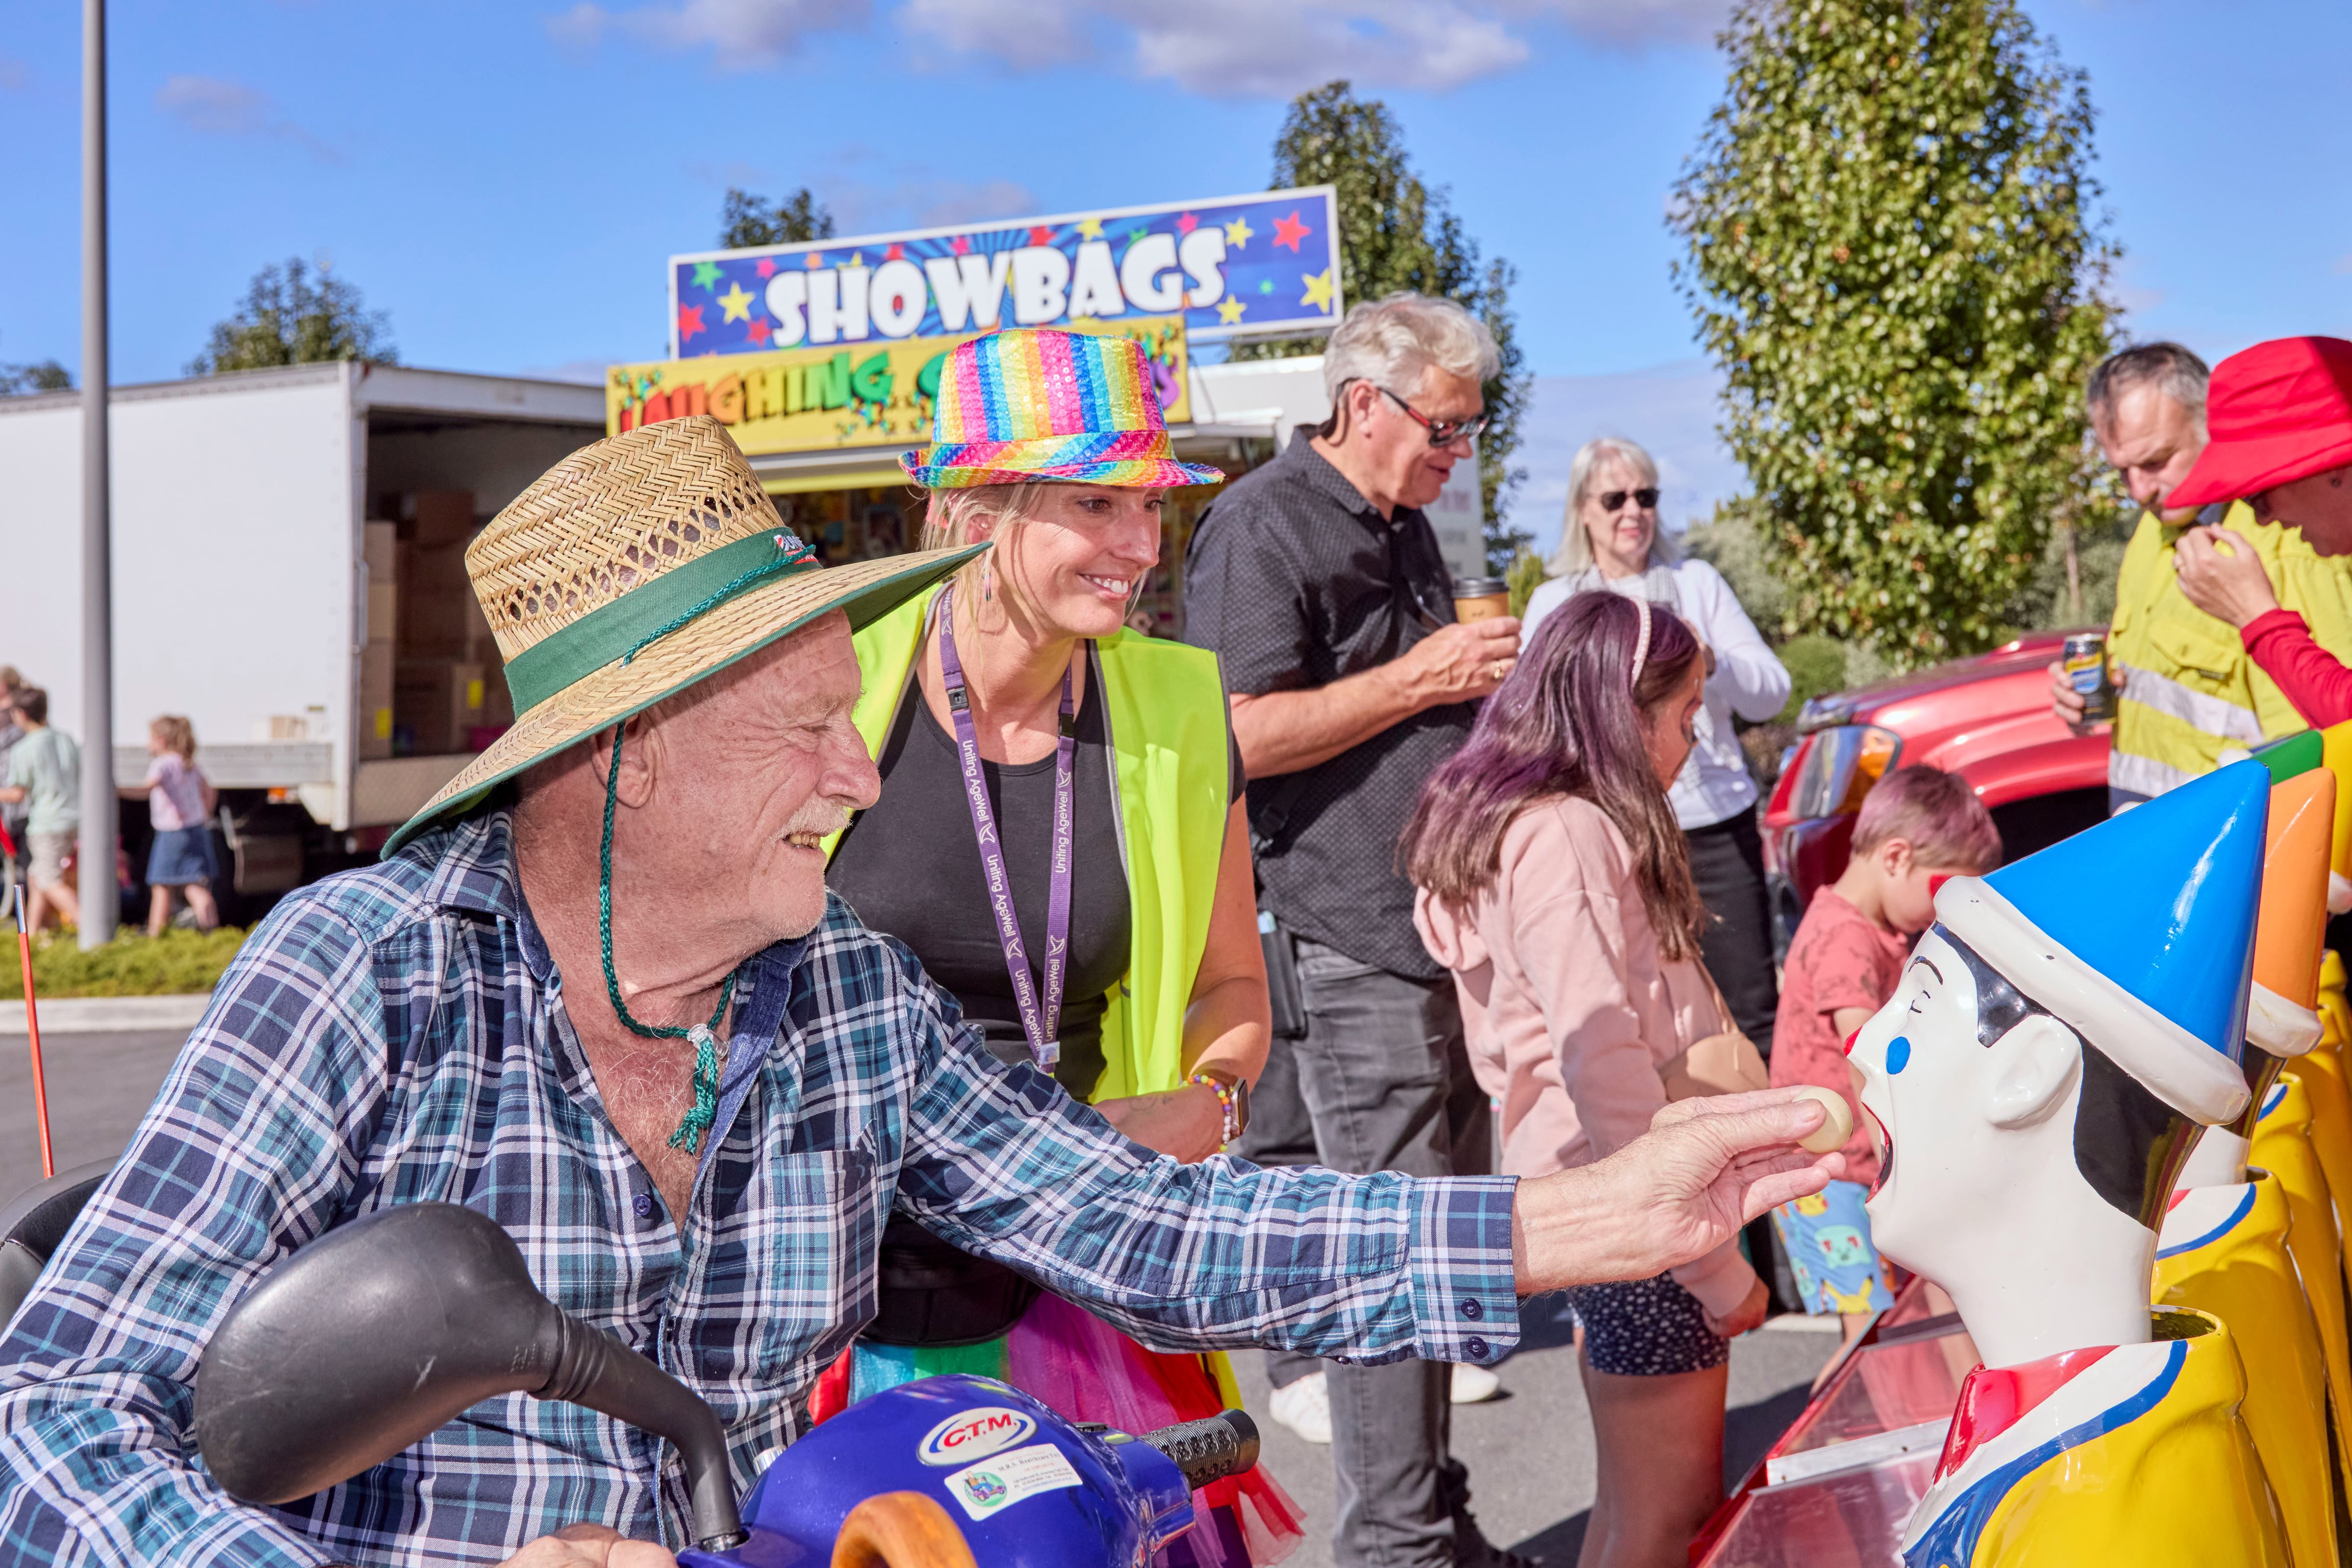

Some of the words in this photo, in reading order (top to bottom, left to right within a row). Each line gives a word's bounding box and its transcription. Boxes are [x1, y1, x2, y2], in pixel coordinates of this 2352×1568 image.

[764, 227, 1226, 348] SHOWBAGS
[962, 739, 977, 777] Uniting
[969, 779, 990, 822] AgeWell
[1057, 791, 1070, 835] AgeWell
[1054, 836, 1070, 873] Uniting
[987, 854, 1003, 892] Uniting
[995, 894, 1016, 937] AgeWell
[1015, 969, 1031, 1007] Uniting
[1048, 959, 1060, 1002] AgeWell
[1045, 1005, 1059, 1041] Uniting
[943, 1413, 1017, 1448] C.T.M.
